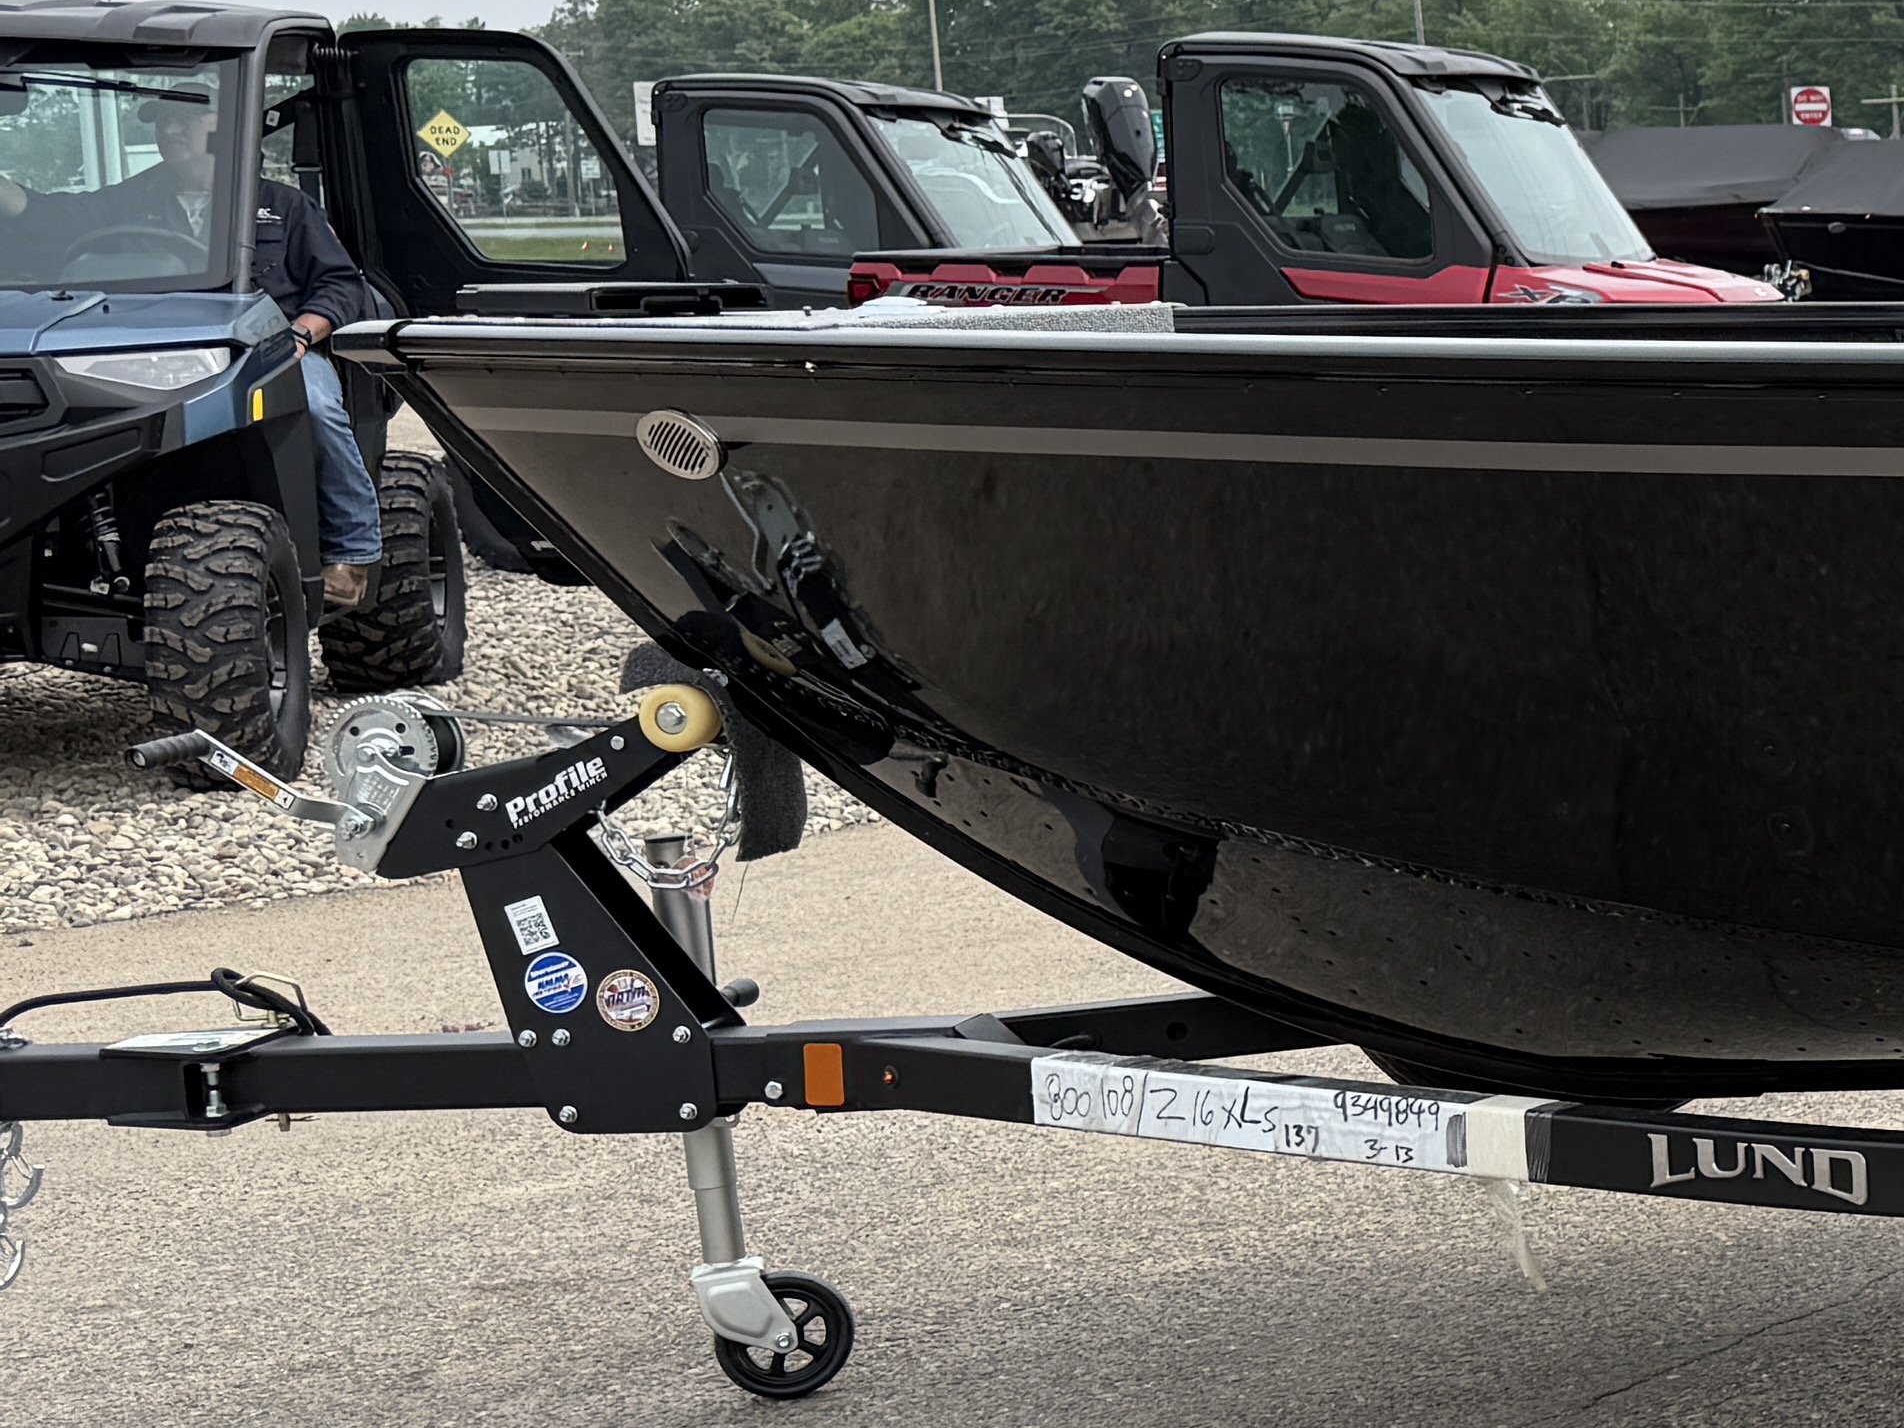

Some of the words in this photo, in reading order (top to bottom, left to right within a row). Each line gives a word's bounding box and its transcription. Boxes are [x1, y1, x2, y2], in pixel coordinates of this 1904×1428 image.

[430, 125, 461, 135] DEAD
[435, 137, 457, 146] END
[907, 284, 1067, 303] RANGER
[504, 756, 606, 824] Profile
[513, 788, 576, 830] PERFORMANCE
[577, 770, 608, 792] WINCH
[1334, 1091, 1440, 1131] 9349849
[1647, 1133, 1869, 1206] LUND
